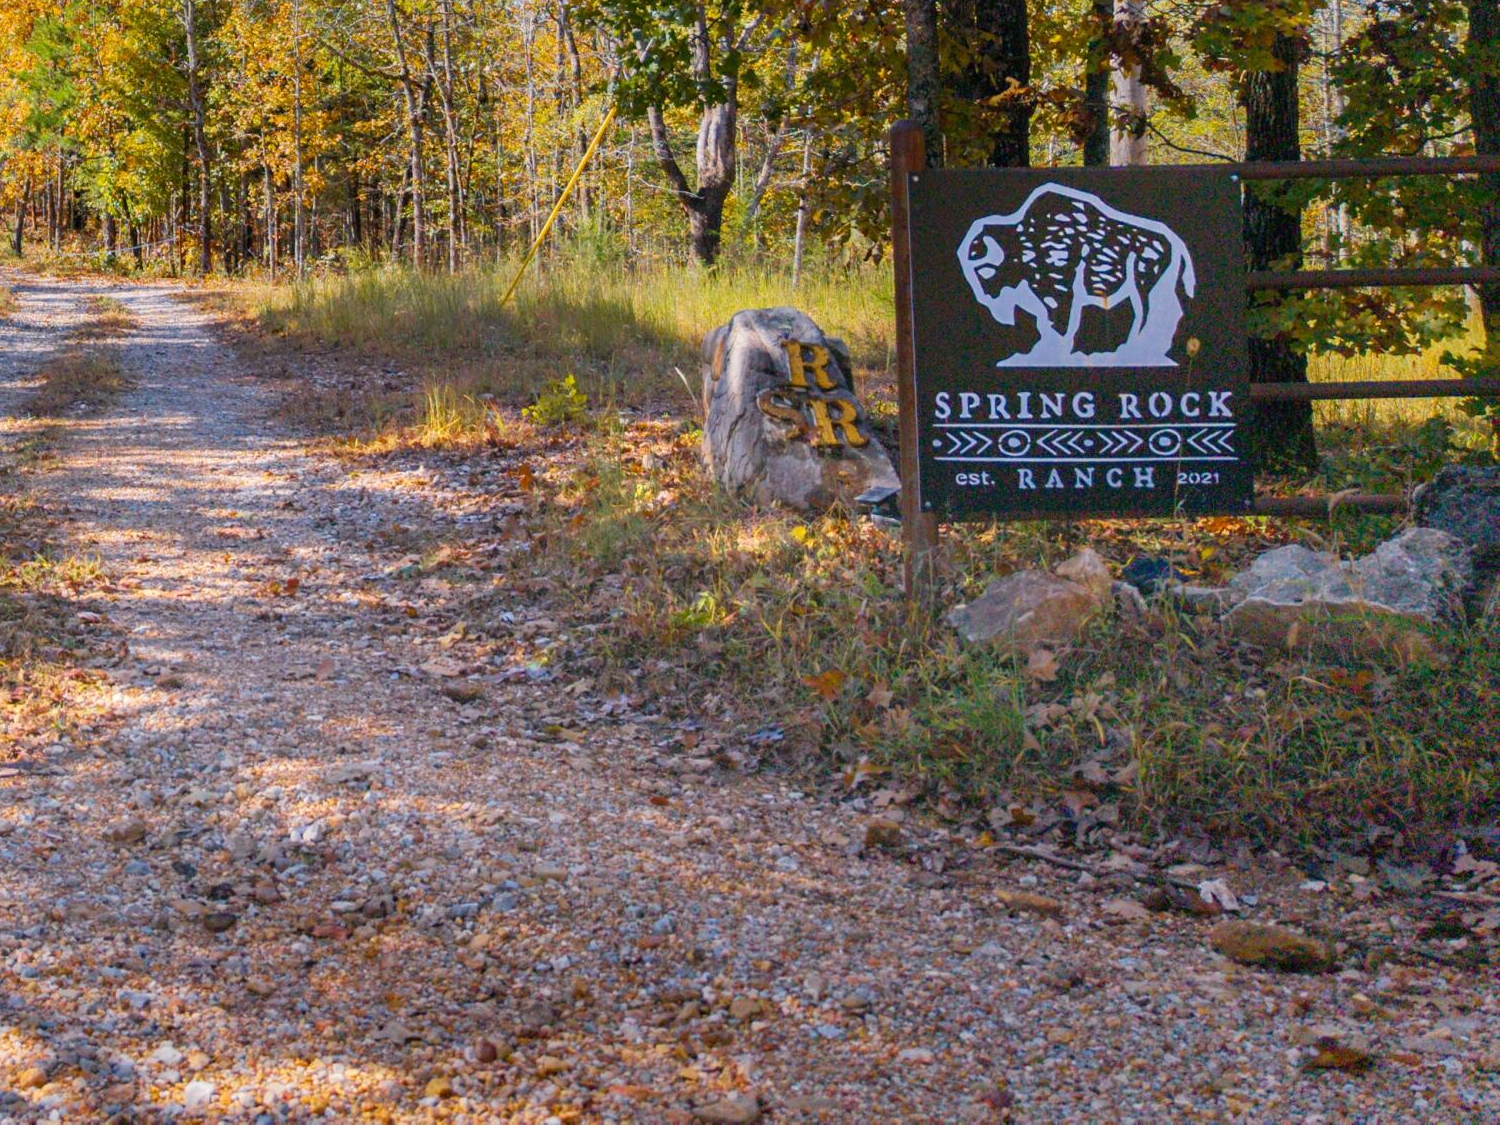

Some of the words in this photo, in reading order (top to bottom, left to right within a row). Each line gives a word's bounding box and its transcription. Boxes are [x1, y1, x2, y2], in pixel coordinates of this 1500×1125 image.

[780, 339, 837, 391] R
[934, 391, 1096, 419] SPRING
[1119, 391, 1233, 418] ROCK
[955, 471, 996, 485] est.
[1017, 467, 1155, 489] RANCH
[1177, 471, 1220, 485] 2021
